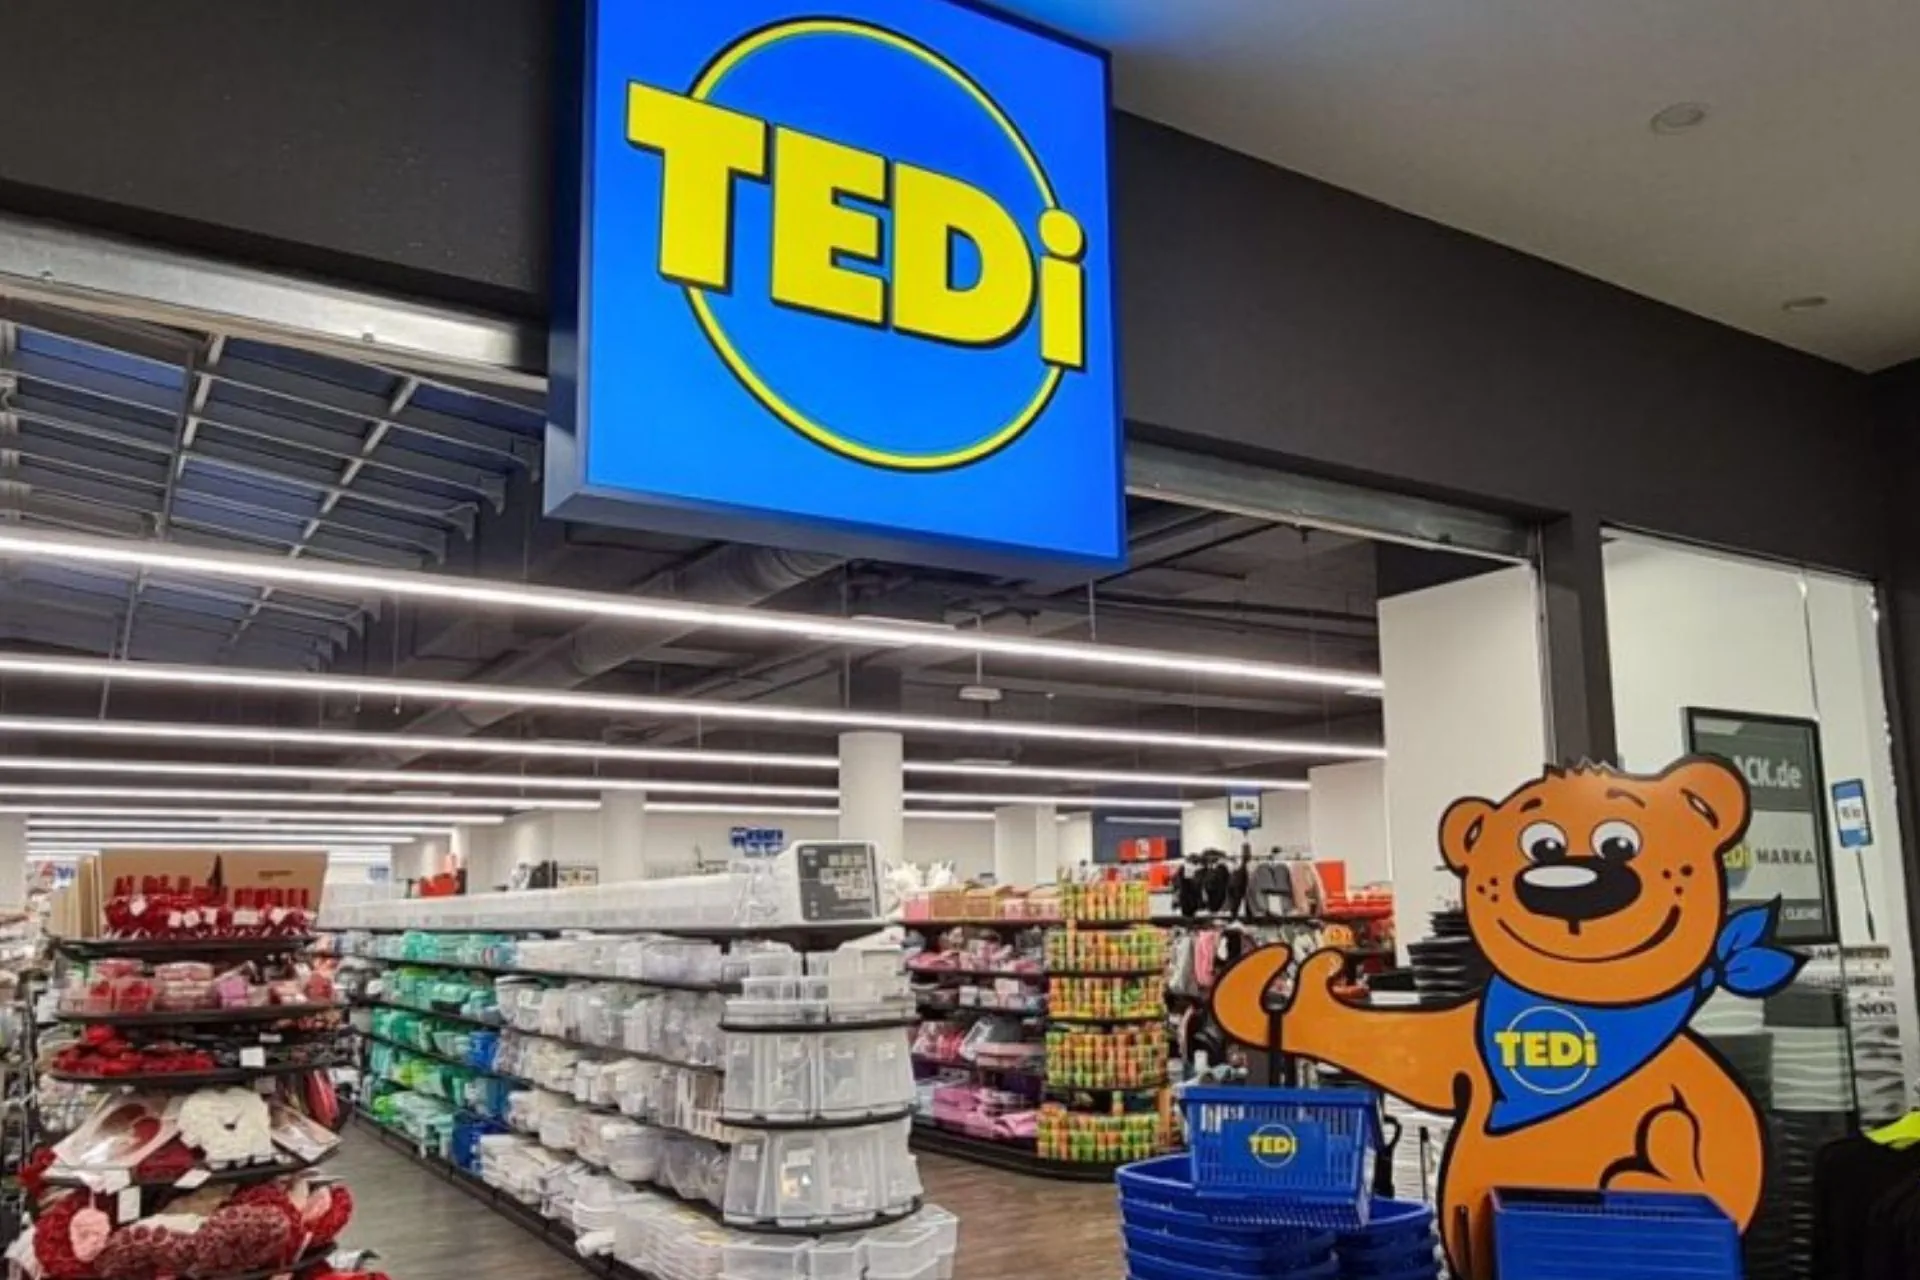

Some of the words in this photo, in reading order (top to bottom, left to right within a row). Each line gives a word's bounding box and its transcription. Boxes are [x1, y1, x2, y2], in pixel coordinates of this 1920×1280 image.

[626, 79, 1086, 371] TEDi
[1756, 848, 1815, 864] MARKA
[1495, 1031, 1598, 1068] TEDi
[1248, 1135, 1298, 1155] TEDi
